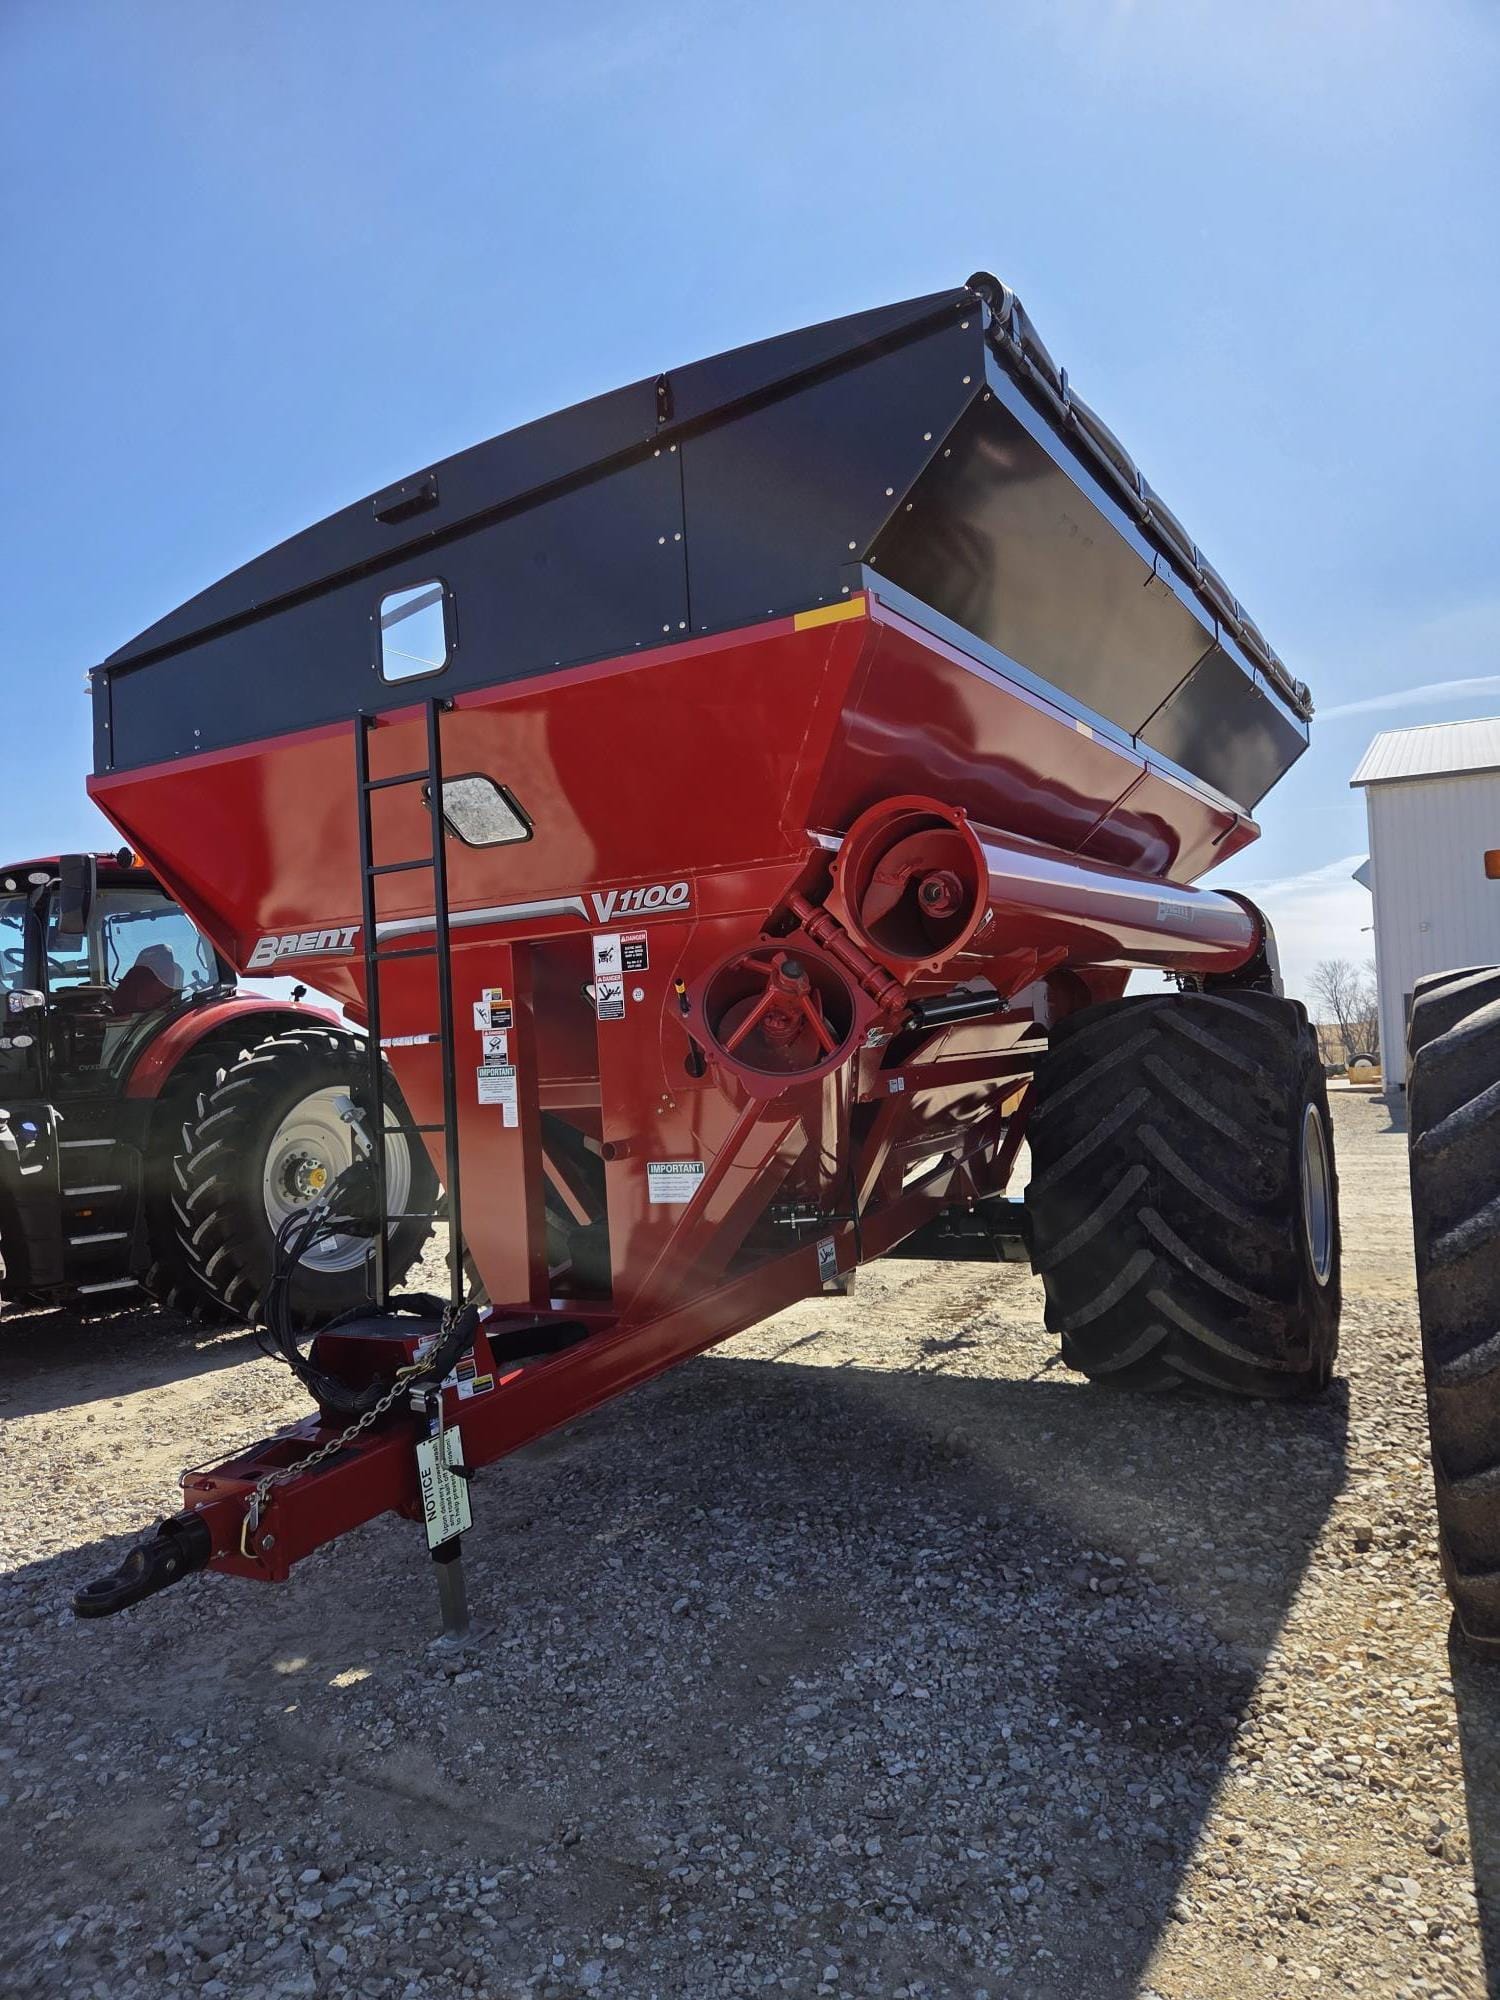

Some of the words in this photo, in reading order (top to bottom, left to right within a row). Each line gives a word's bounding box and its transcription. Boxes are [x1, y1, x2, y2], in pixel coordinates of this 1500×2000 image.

[591, 883, 689, 923] V1100
[625, 933, 646, 941] DANGER
[246, 925, 361, 968] BRENT
[479, 1067, 513, 1077] IMPORTANT
[650, 1164, 700, 1173] IMPORTANT
[446, 1439, 454, 1466] rrosion!
[435, 1463, 443, 1485] power
[421, 1467, 437, 1523] NOTICE
[444, 1497, 453, 1513] road
[452, 1501, 461, 1517] help
[455, 1516, 461, 1526] to
